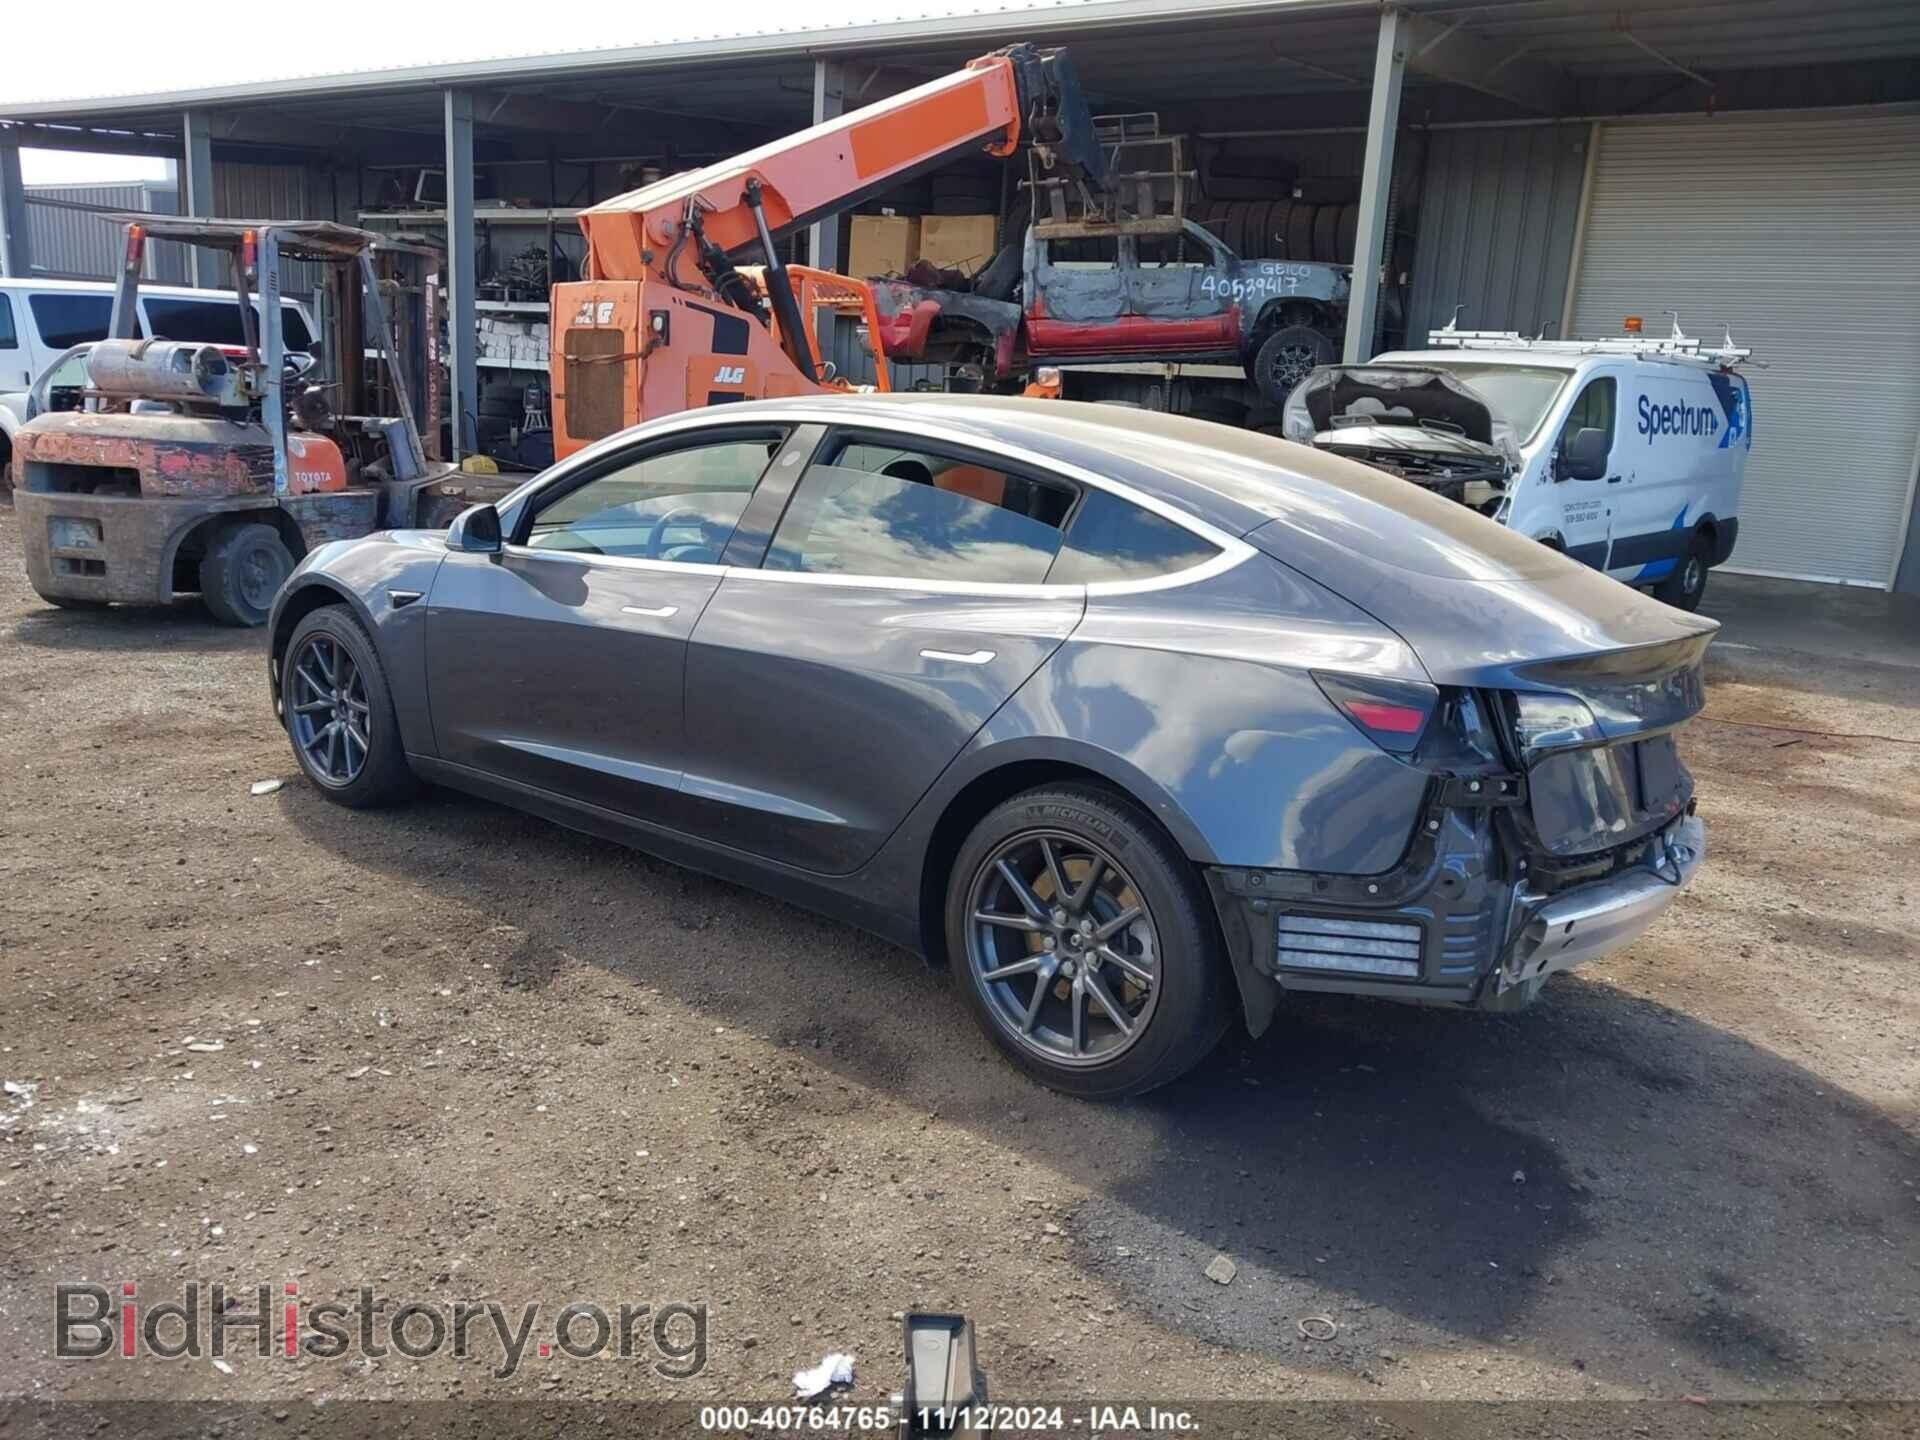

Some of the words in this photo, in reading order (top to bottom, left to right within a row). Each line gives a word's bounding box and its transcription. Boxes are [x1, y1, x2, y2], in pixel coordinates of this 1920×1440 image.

[1260, 263, 1311, 277] GEICO
[1201, 275, 1300, 301] 40539417
[713, 366, 745, 384] JLG
[1638, 394, 1719, 446] Spectrum
[294, 471, 333, 482] TOYOTA
[1041, 805, 1112, 834] MICHELIN
